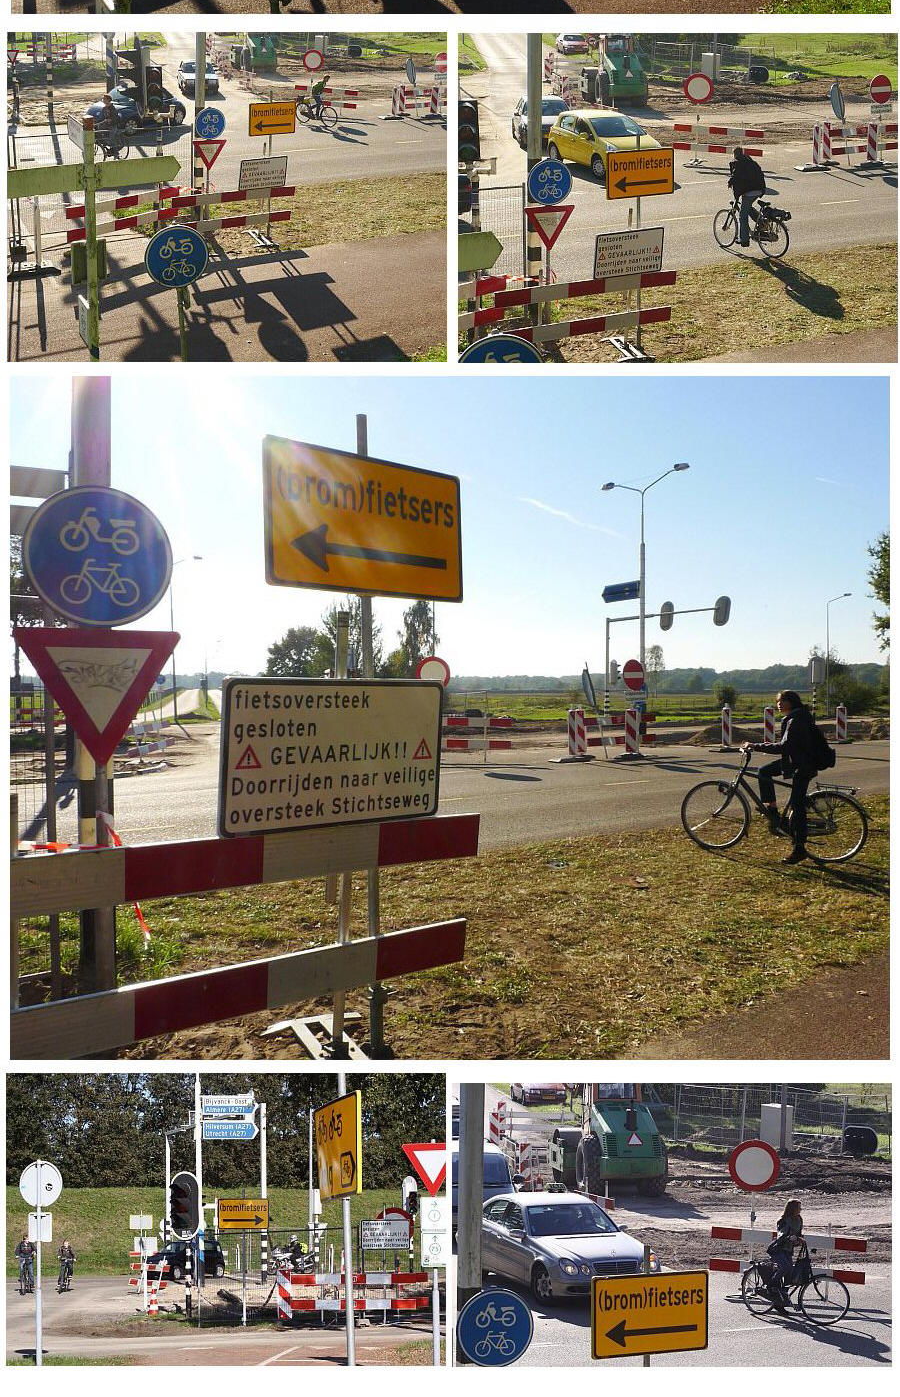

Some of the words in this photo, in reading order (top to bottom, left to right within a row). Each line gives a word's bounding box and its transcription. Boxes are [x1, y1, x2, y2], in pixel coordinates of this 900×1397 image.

[610, 157, 672, 172] (brom)fietsers
[598, 233, 639, 244] fietsoversteek
[607, 247, 652, 259] GEVAARLIJK!!
[625, 263, 659, 273] Stichtseweg
[276, 464, 454, 529] (brom)fietsers
[235, 690, 370, 709] fietsoversteek
[234, 719, 317, 743] gesloten
[271, 741, 408, 765] GEVAARLIJK!!
[232, 773, 333, 797] Doorrijden
[340, 772, 379, 788] naar
[384, 766, 435, 787] veilige
[230, 798, 325, 824] oversteek
[332, 792, 430, 815] Stichtseweg
[598, 1286, 704, 1312] (brom)fietsers
